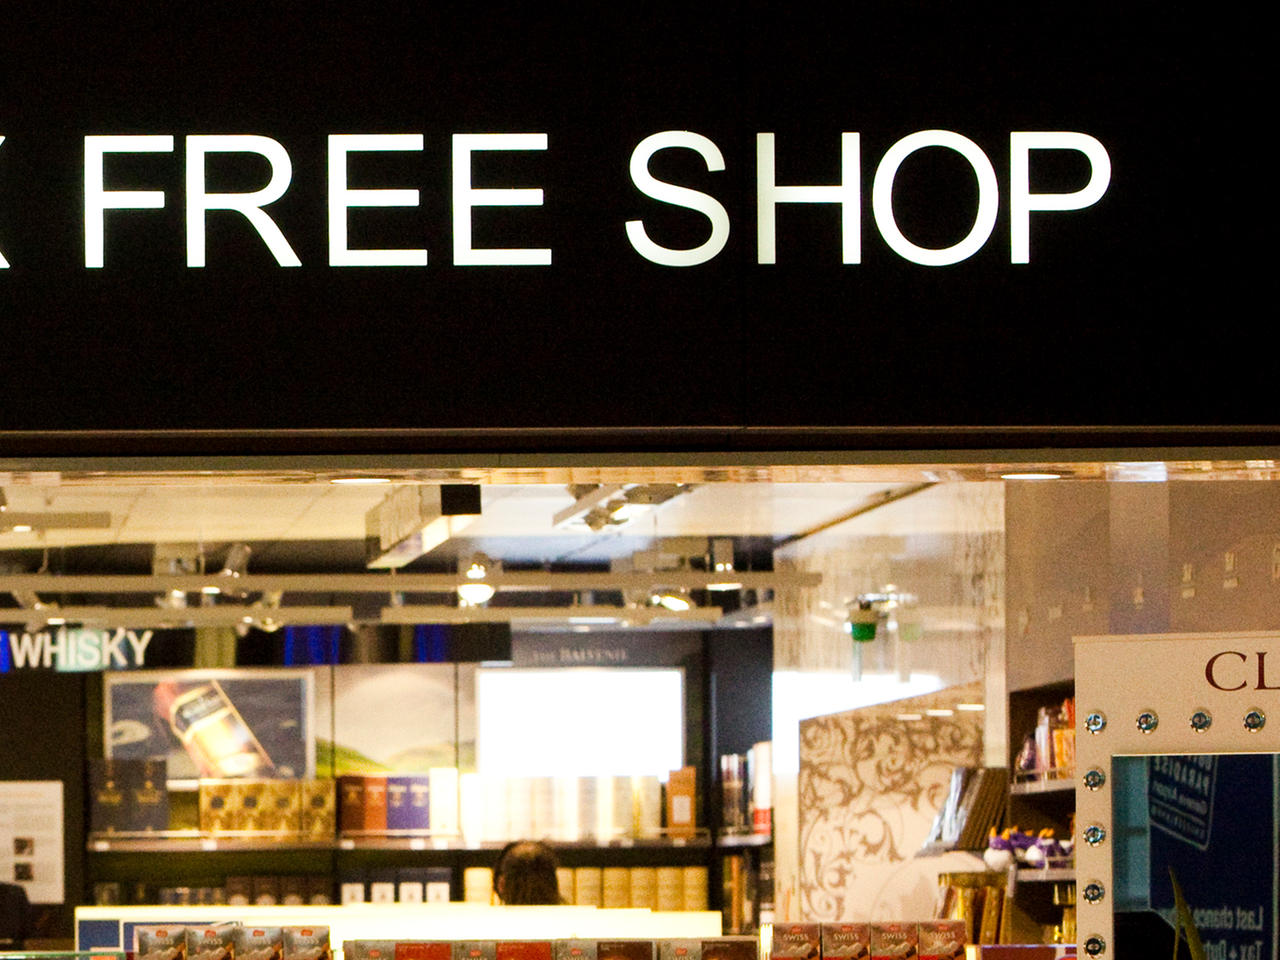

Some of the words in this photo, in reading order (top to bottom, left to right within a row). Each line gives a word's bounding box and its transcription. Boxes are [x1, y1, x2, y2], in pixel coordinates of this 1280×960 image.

[83, 132, 553, 270] FREE
[624, 129, 1112, 268] SHOP
[9, 629, 154, 669] WHISKY
